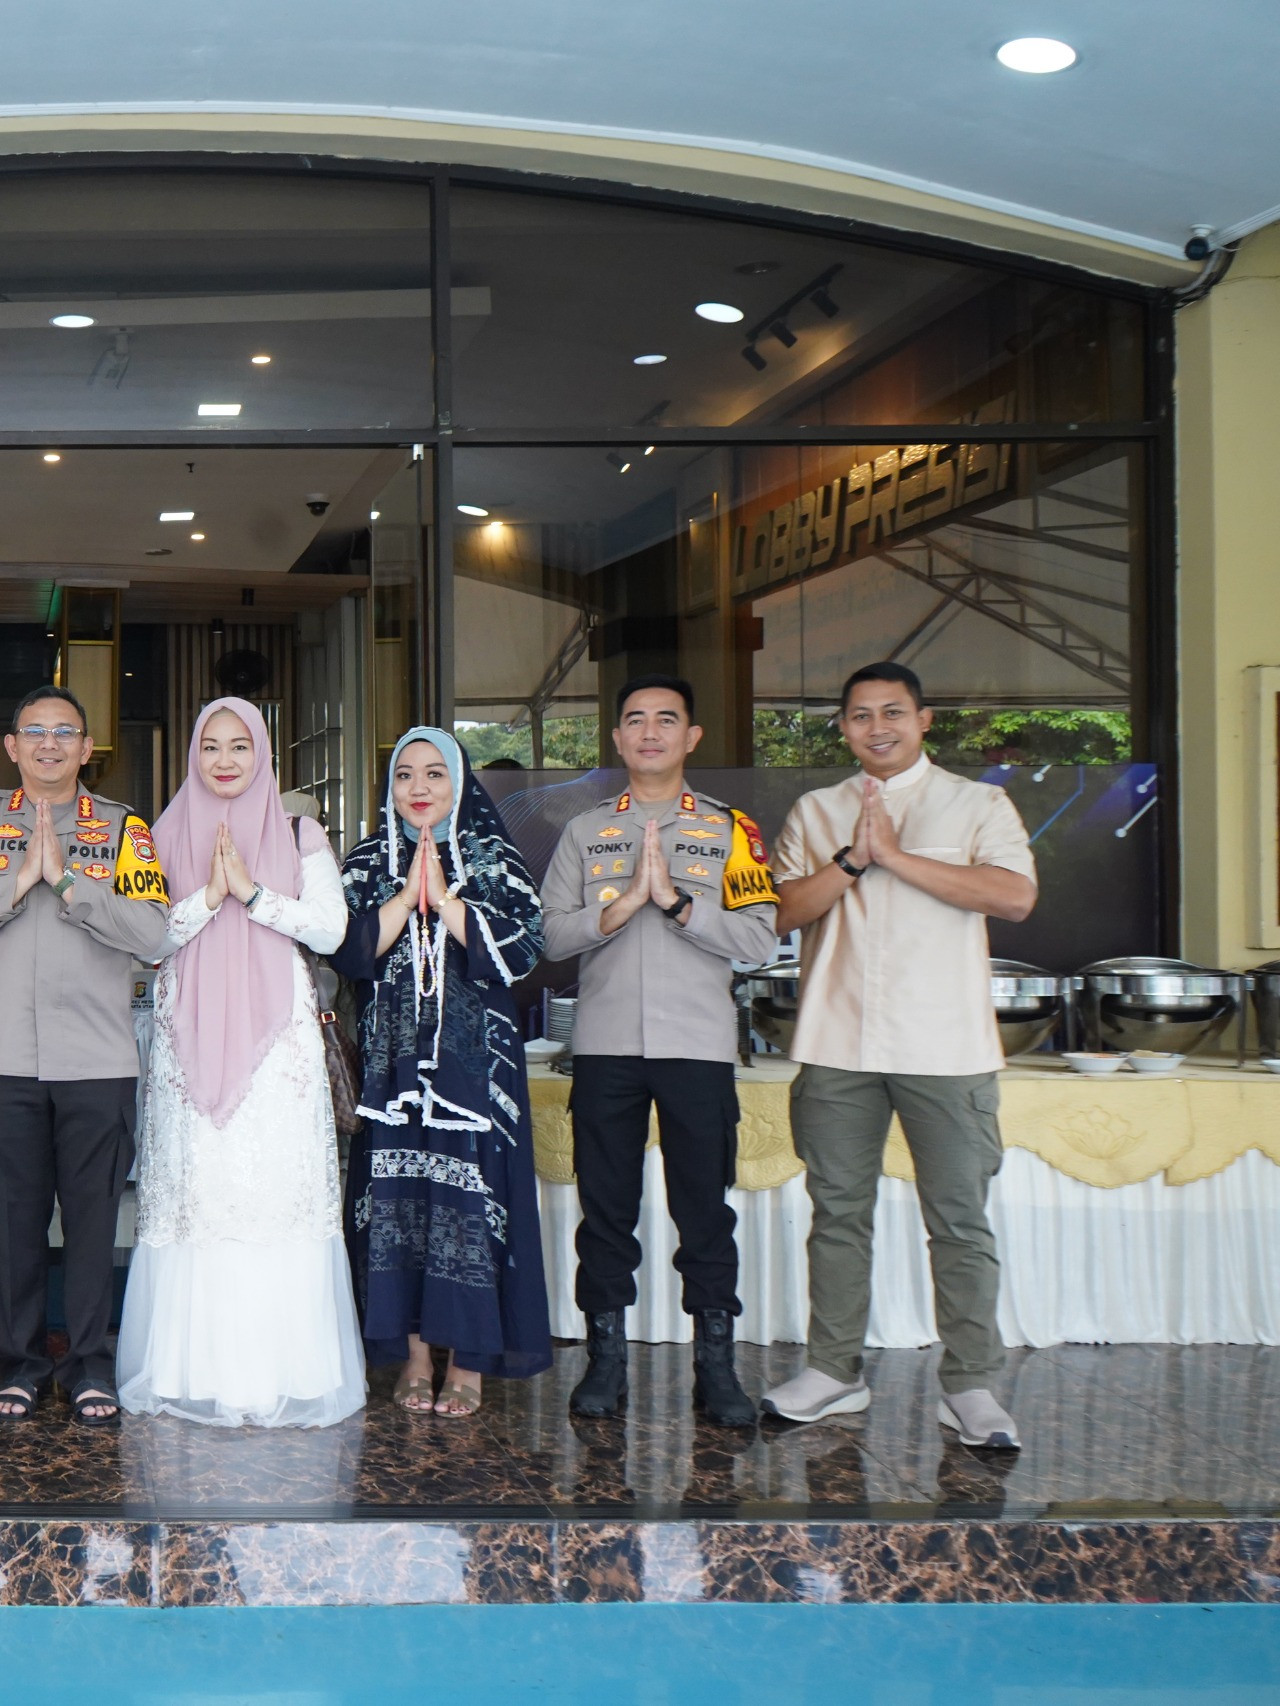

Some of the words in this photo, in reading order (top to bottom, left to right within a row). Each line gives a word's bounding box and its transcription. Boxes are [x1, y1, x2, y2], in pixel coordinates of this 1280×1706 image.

[732, 477, 842, 597] LOBBY
[69, 845, 116, 860] POLRI
[587, 842, 633, 855] YONKY
[675, 843, 726, 859] POLRI
